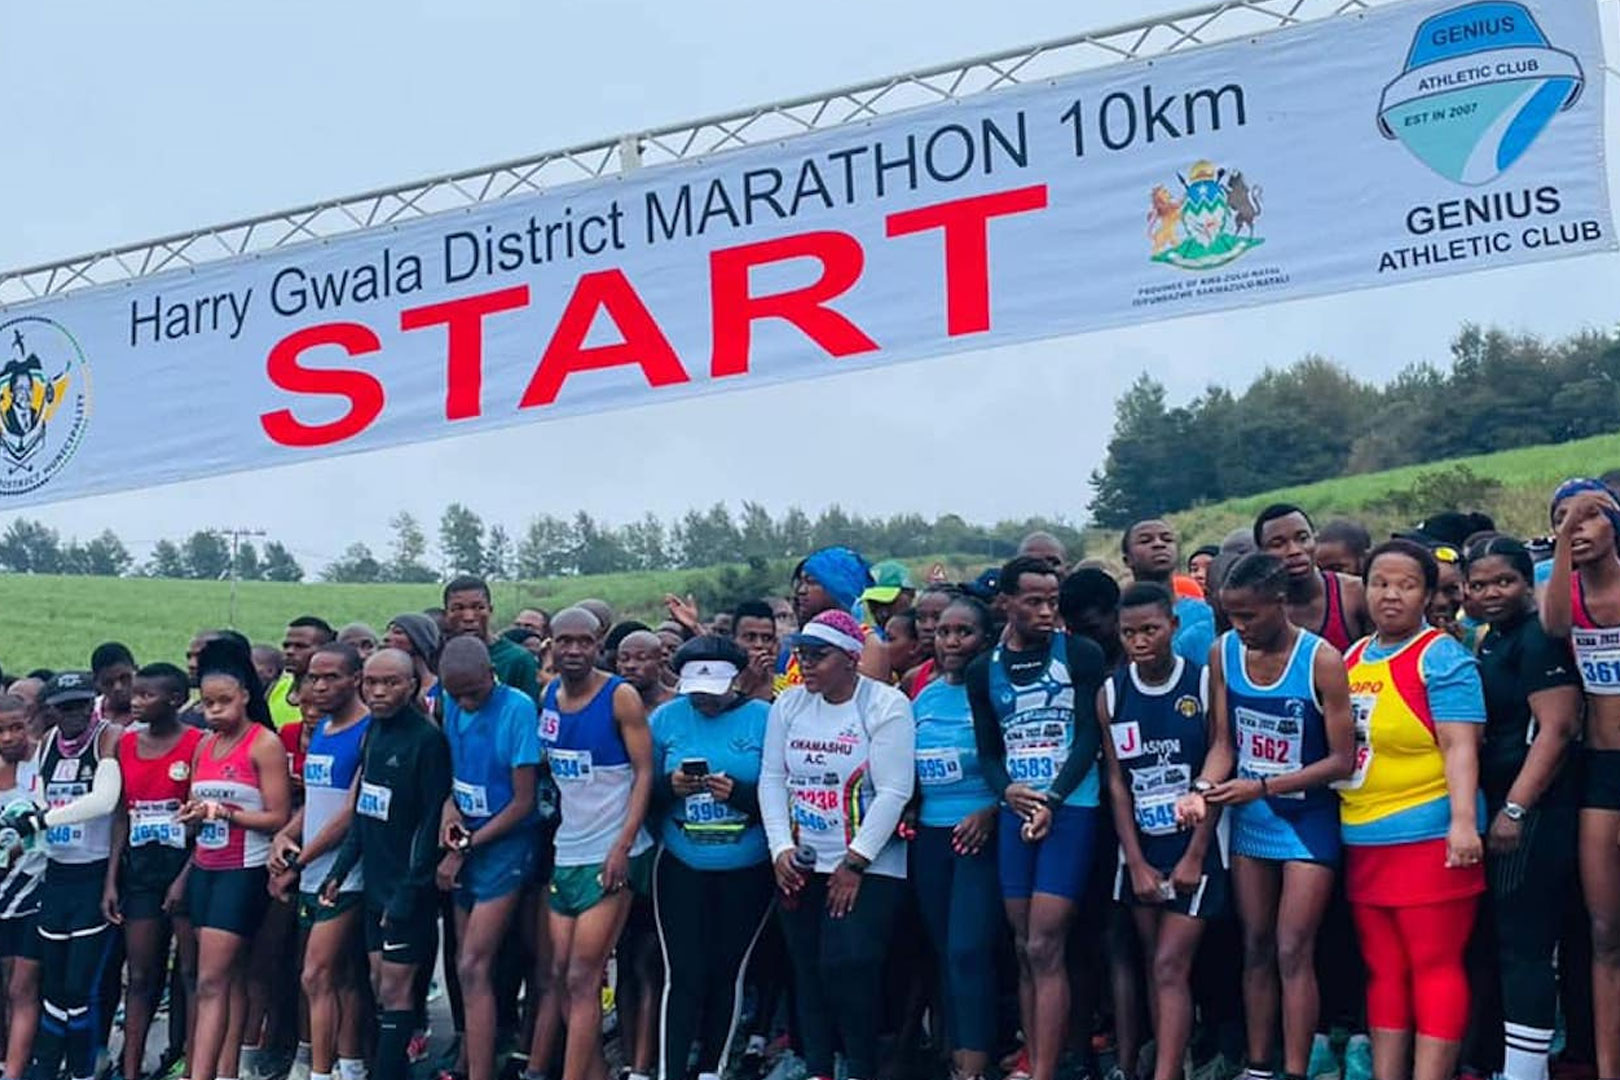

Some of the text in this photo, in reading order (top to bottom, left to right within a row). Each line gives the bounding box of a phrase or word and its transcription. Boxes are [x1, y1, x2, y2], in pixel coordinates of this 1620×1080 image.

[1432, 16, 1515, 46] GENIUS
[1418, 59, 1539, 92] ATHLETIC CLUB
[1404, 103, 1479, 127] EST IN 2007
[131, 84, 1246, 346] Harry Gwala District MARATHON 10km
[1406, 186, 1562, 235] GENIUS
[1378, 220, 1602, 273] ATHLETIC CLUB
[261, 186, 1047, 447] START
[1120, 727, 1135, 753] J
[1251, 733, 1289, 764] 562
